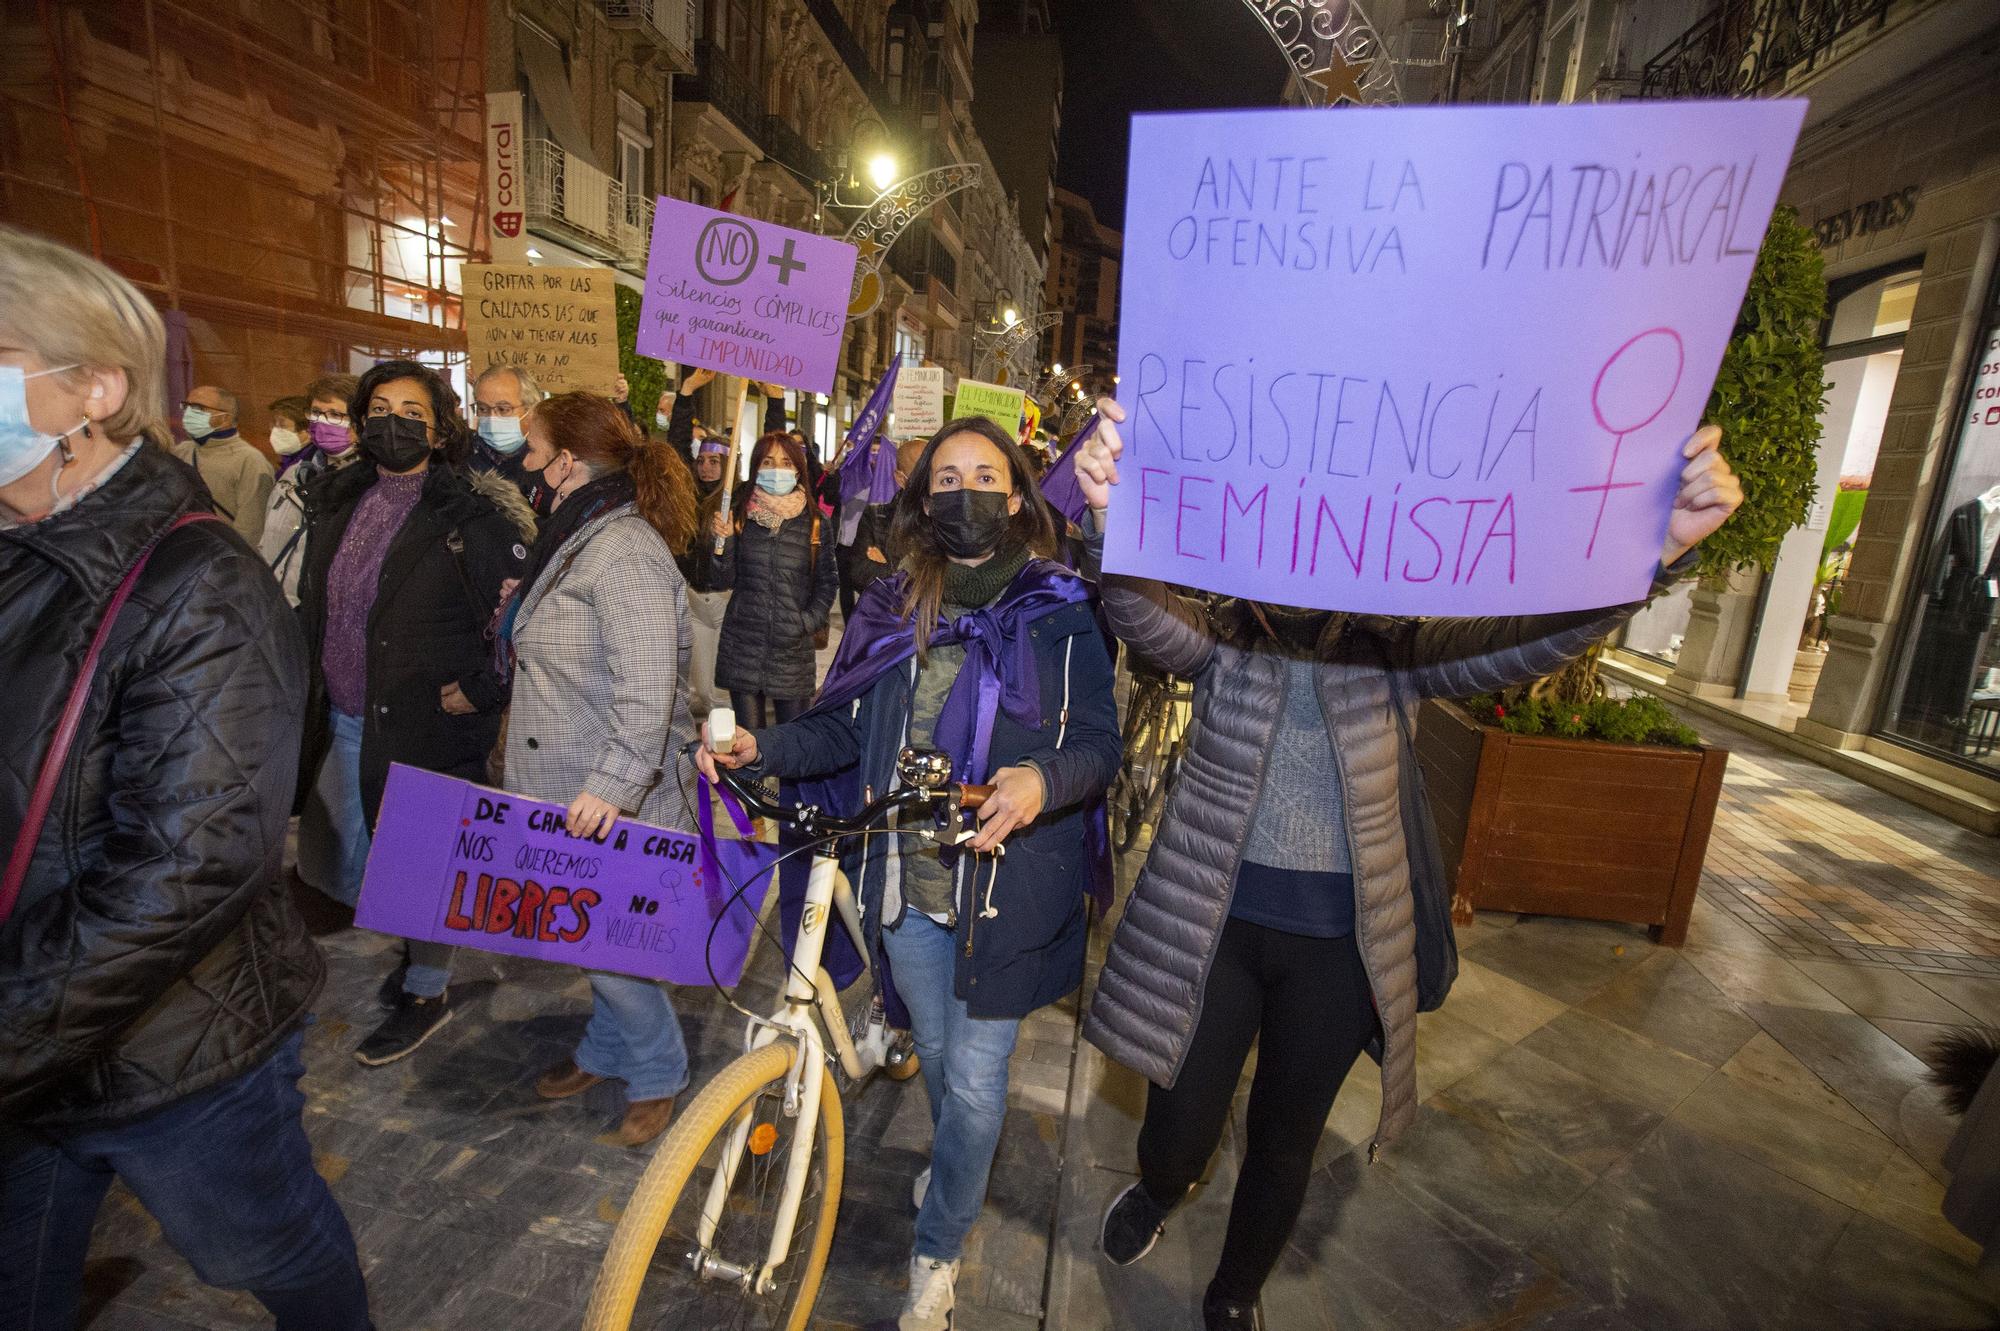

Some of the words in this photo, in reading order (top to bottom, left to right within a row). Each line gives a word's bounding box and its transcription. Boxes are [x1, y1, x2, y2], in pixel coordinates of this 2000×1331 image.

[491, 123, 512, 206] corral
[1192, 156, 1328, 214] ANTE
[1364, 159, 1425, 212] LA
[706, 226, 749, 266] NO
[1167, 215, 1406, 274] OFENSIVA
[483, 271, 535, 291] GRITAR
[543, 275, 562, 289] POR
[570, 277, 592, 292] LAS
[656, 274, 742, 315] Silencios
[556, 304, 574, 322] LAS
[579, 307, 600, 323] QUE
[655, 308, 680, 329] que
[688, 314, 776, 344] garanticen
[511, 329, 524, 341] NO
[528, 329, 565, 342] TIENEN
[667, 328, 687, 356] LA
[694, 337, 803, 378] IMPUNIDAD
[487, 350, 507, 366] LAS
[512, 352, 528, 366] QUE
[534, 352, 546, 365] YA
[554, 354, 570, 366] NO
[1132, 352, 1545, 482] RESISTENCIA
[1136, 467, 1516, 585] FEMINISTA
[474, 797, 510, 825] DE
[613, 829, 629, 852] A
[643, 834, 697, 865] CASA
[455, 829, 498, 863] NOS
[515, 843, 603, 879] QUEREMOS
[629, 895, 659, 916] NO
[605, 916, 680, 954] VALIENTES
